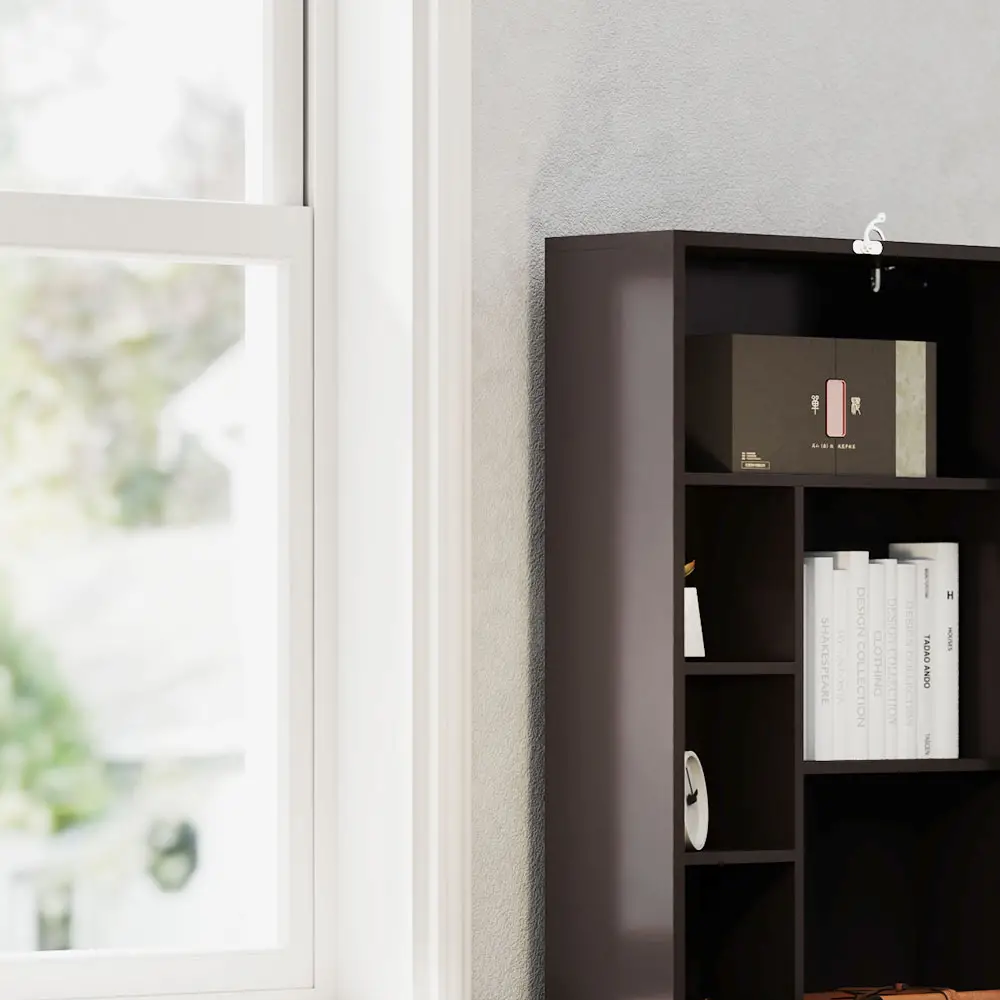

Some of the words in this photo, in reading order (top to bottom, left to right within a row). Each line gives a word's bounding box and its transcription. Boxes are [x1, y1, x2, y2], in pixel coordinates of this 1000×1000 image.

[820, 618, 830, 705] SHAKESPEARE
[855, 641, 866, 728] COLLECTION
[873, 630, 883, 697] CLOTHING
